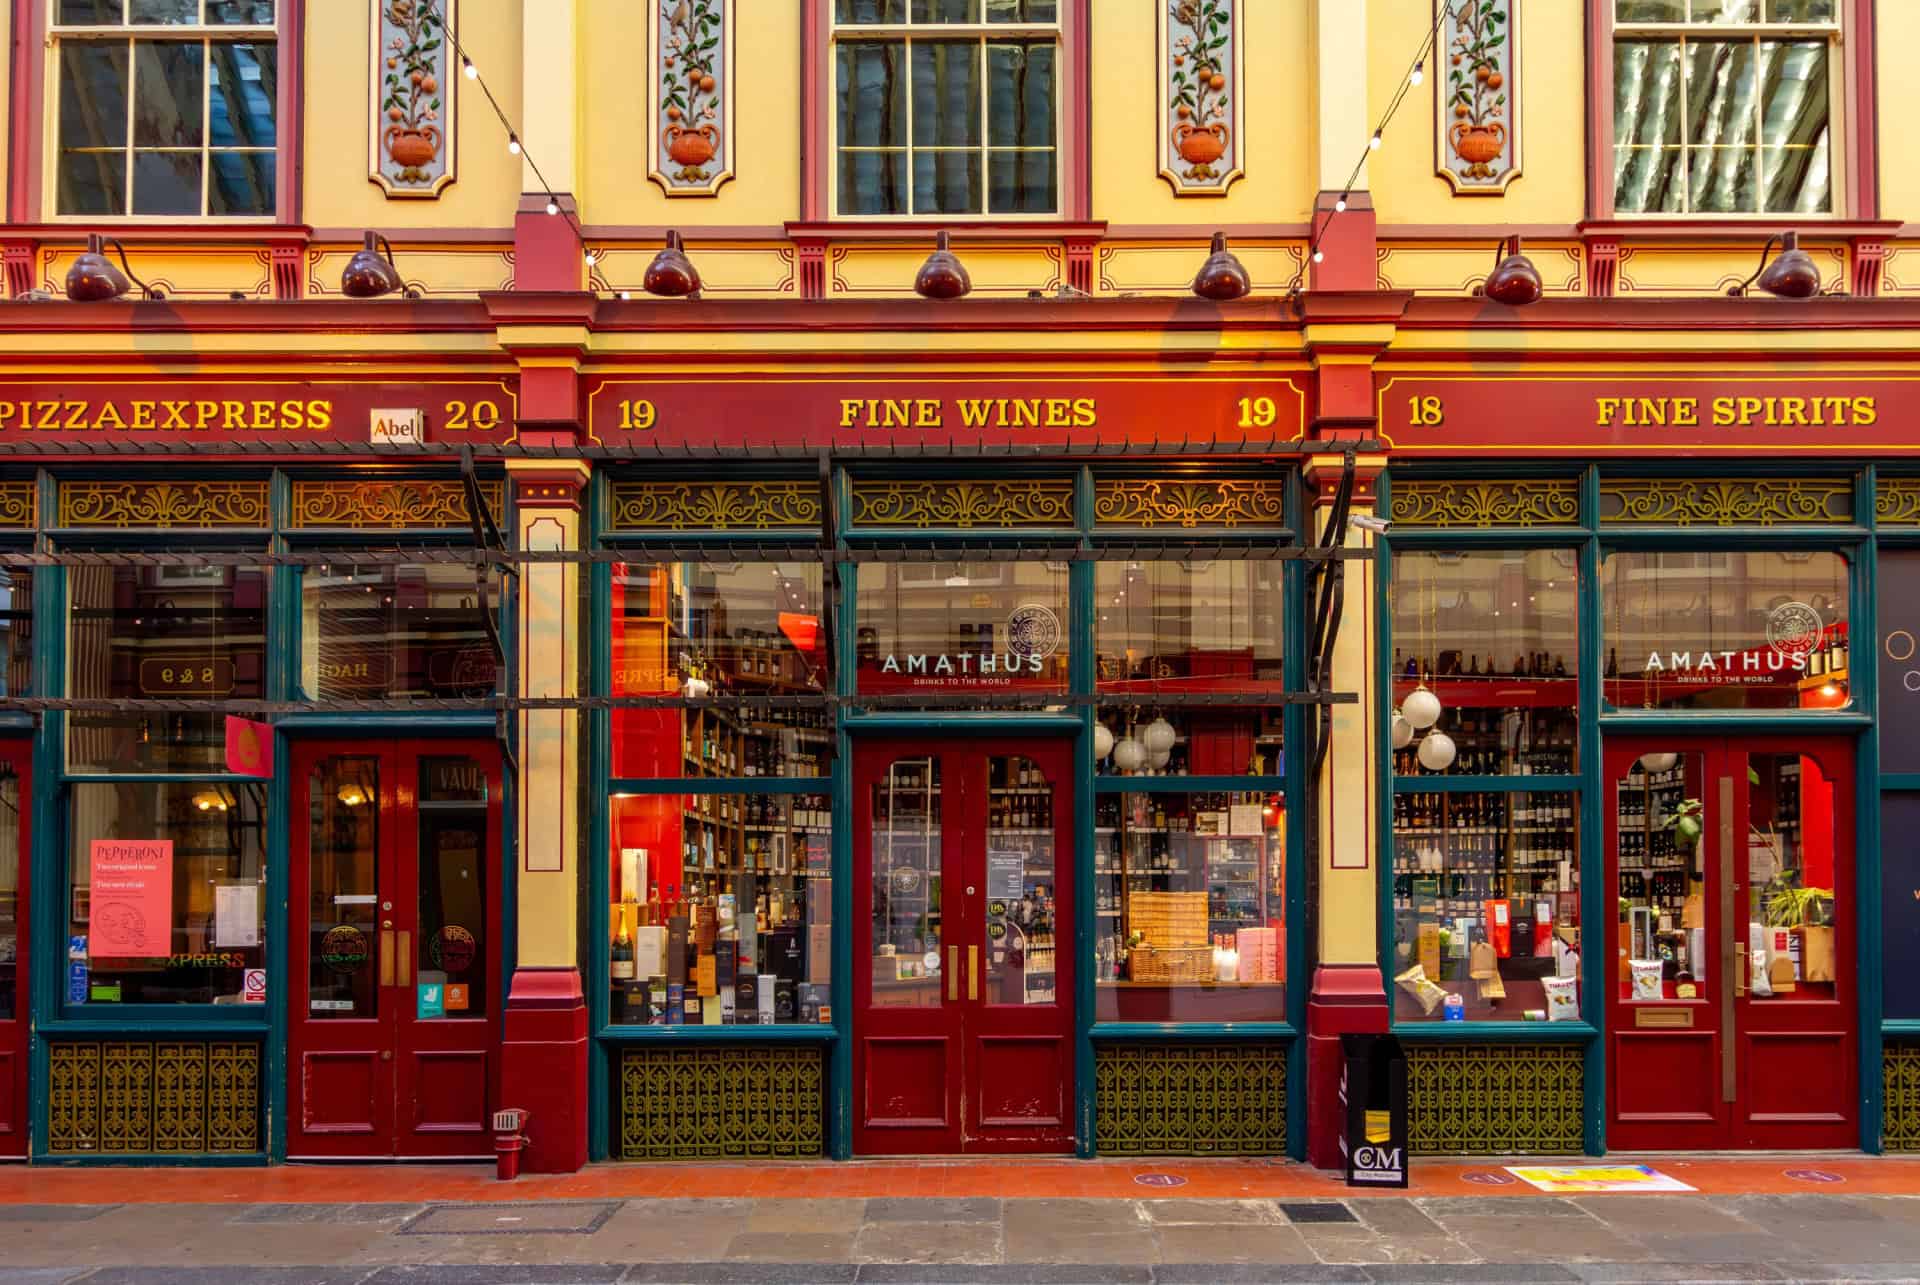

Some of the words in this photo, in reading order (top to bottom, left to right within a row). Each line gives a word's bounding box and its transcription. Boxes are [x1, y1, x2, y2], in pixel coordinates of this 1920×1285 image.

[0, 400, 333, 430] PIZZAEXPRESS
[445, 400, 499, 430] 20
[618, 399, 656, 430] 19
[839, 399, 943, 428] FINE
[956, 399, 1097, 428] WINES
[1237, 396, 1277, 428] 19
[1408, 395, 1444, 426] 18
[1595, 397, 1699, 426] FINE
[1712, 397, 1878, 426] SPIRITS
[373, 417, 416, 438] Abel
[881, 653, 1044, 674] AMATHUS
[1645, 651, 1807, 671] AMATHUS
[913, 678, 945, 686] DRINKS
[948, 678, 959, 686] TO
[962, 678, 977, 686] THE
[980, 678, 1011, 686] WORLD
[95, 846, 165, 861] PEPPERONI
